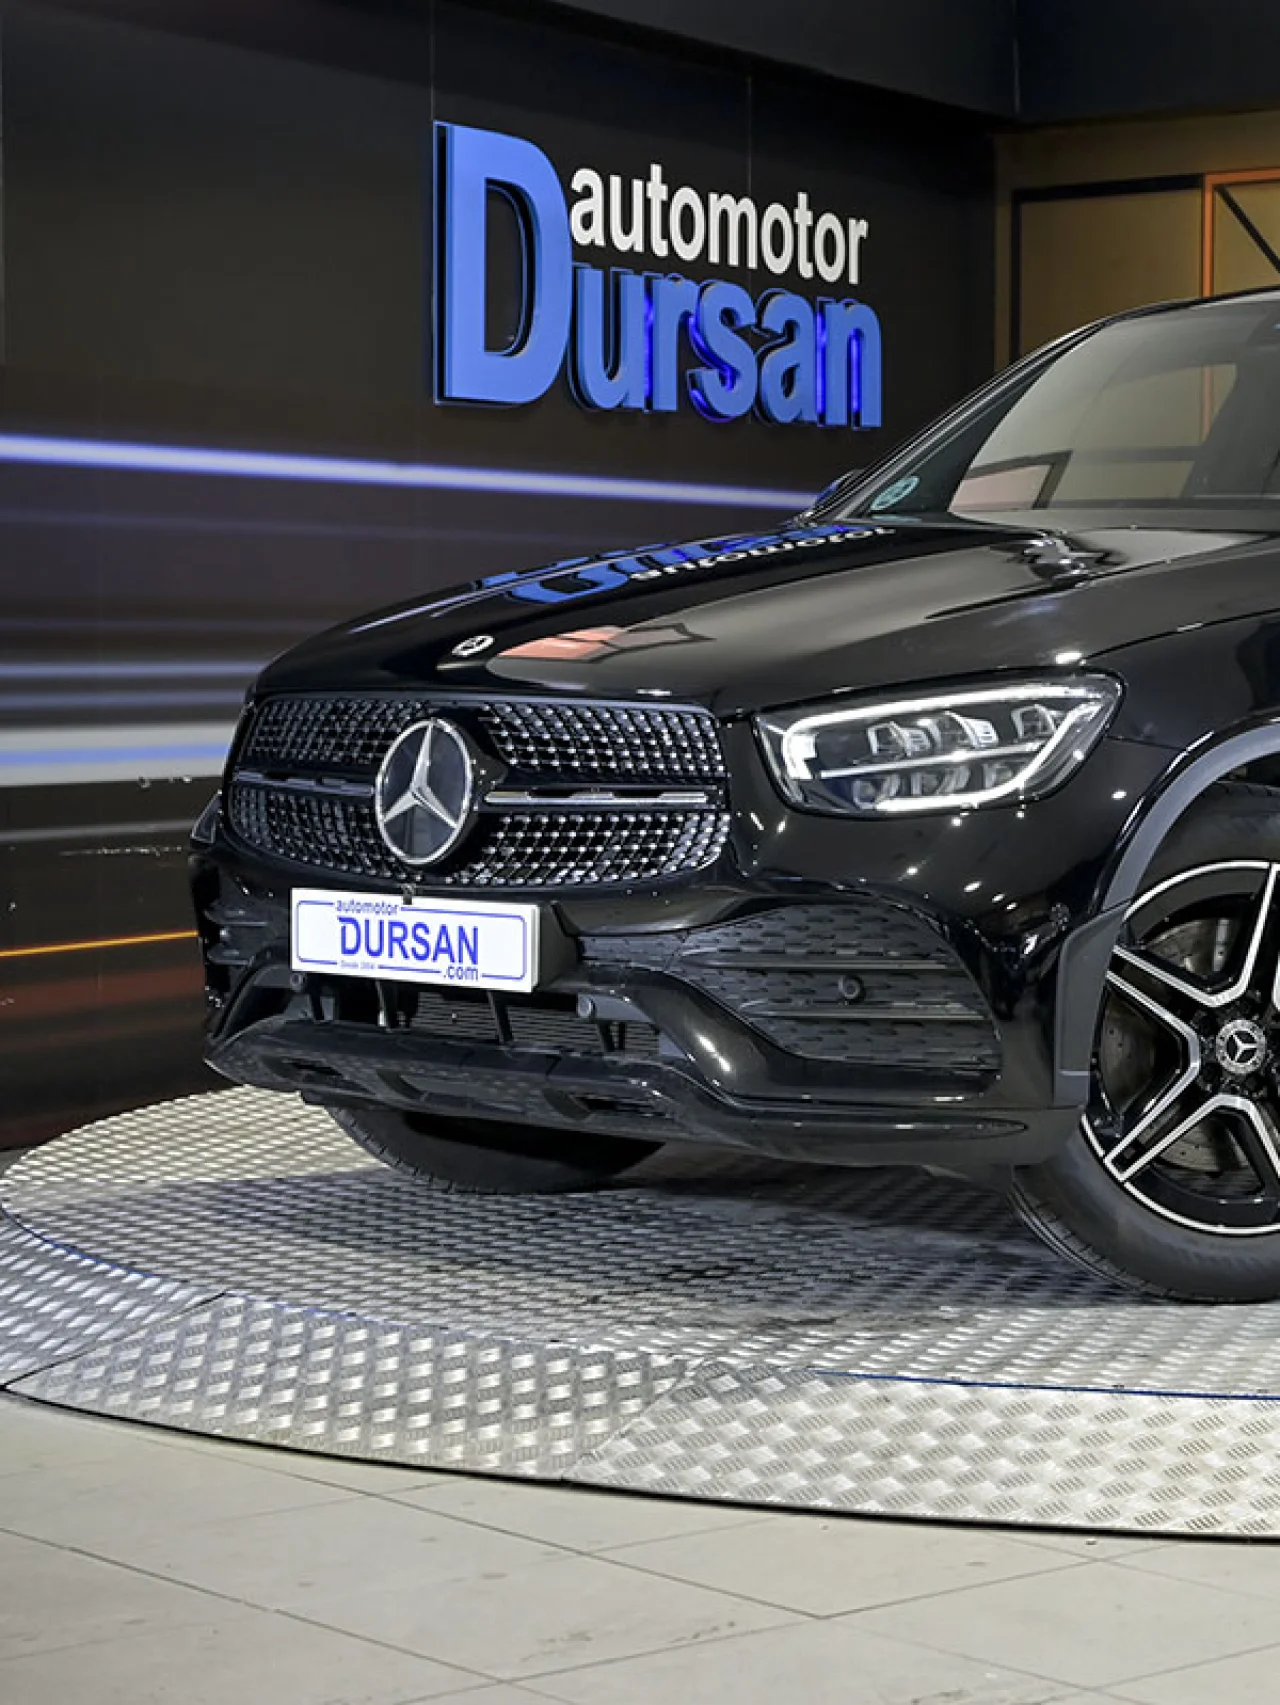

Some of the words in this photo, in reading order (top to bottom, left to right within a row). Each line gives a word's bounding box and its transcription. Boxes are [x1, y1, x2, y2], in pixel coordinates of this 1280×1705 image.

[569, 163, 869, 285] automotor
[434, 119, 883, 429] Dursan
[335, 899, 400, 915] automotor
[336, 915, 479, 966] DURSAN
[442, 965, 479, 981] .com
